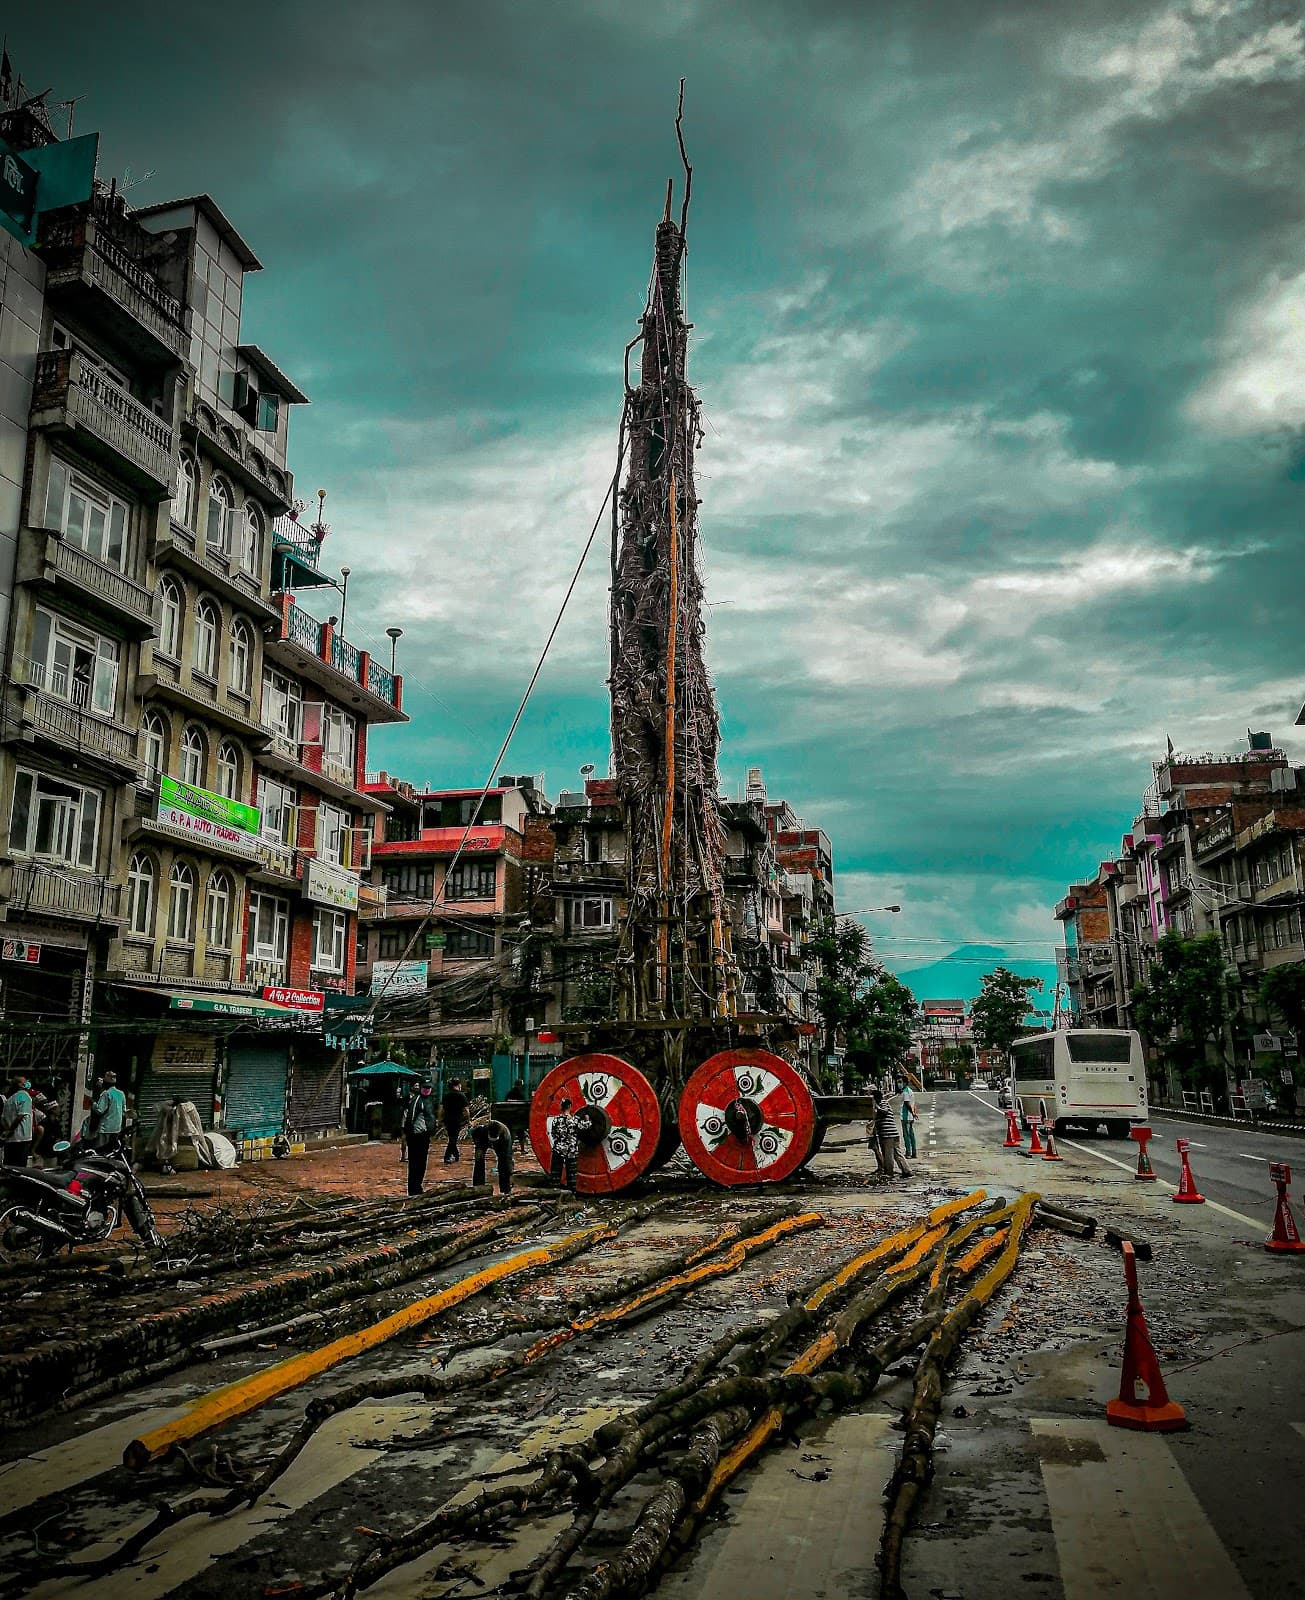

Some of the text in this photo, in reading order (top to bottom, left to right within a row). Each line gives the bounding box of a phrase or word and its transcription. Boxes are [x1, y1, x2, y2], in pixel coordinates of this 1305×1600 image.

[193, 819, 211, 834] AUTO
[213, 825, 239, 843] TRADERS
[269, 989, 320, 1005] A To Z Collection
[938, 1016, 961, 1024] MetLife
